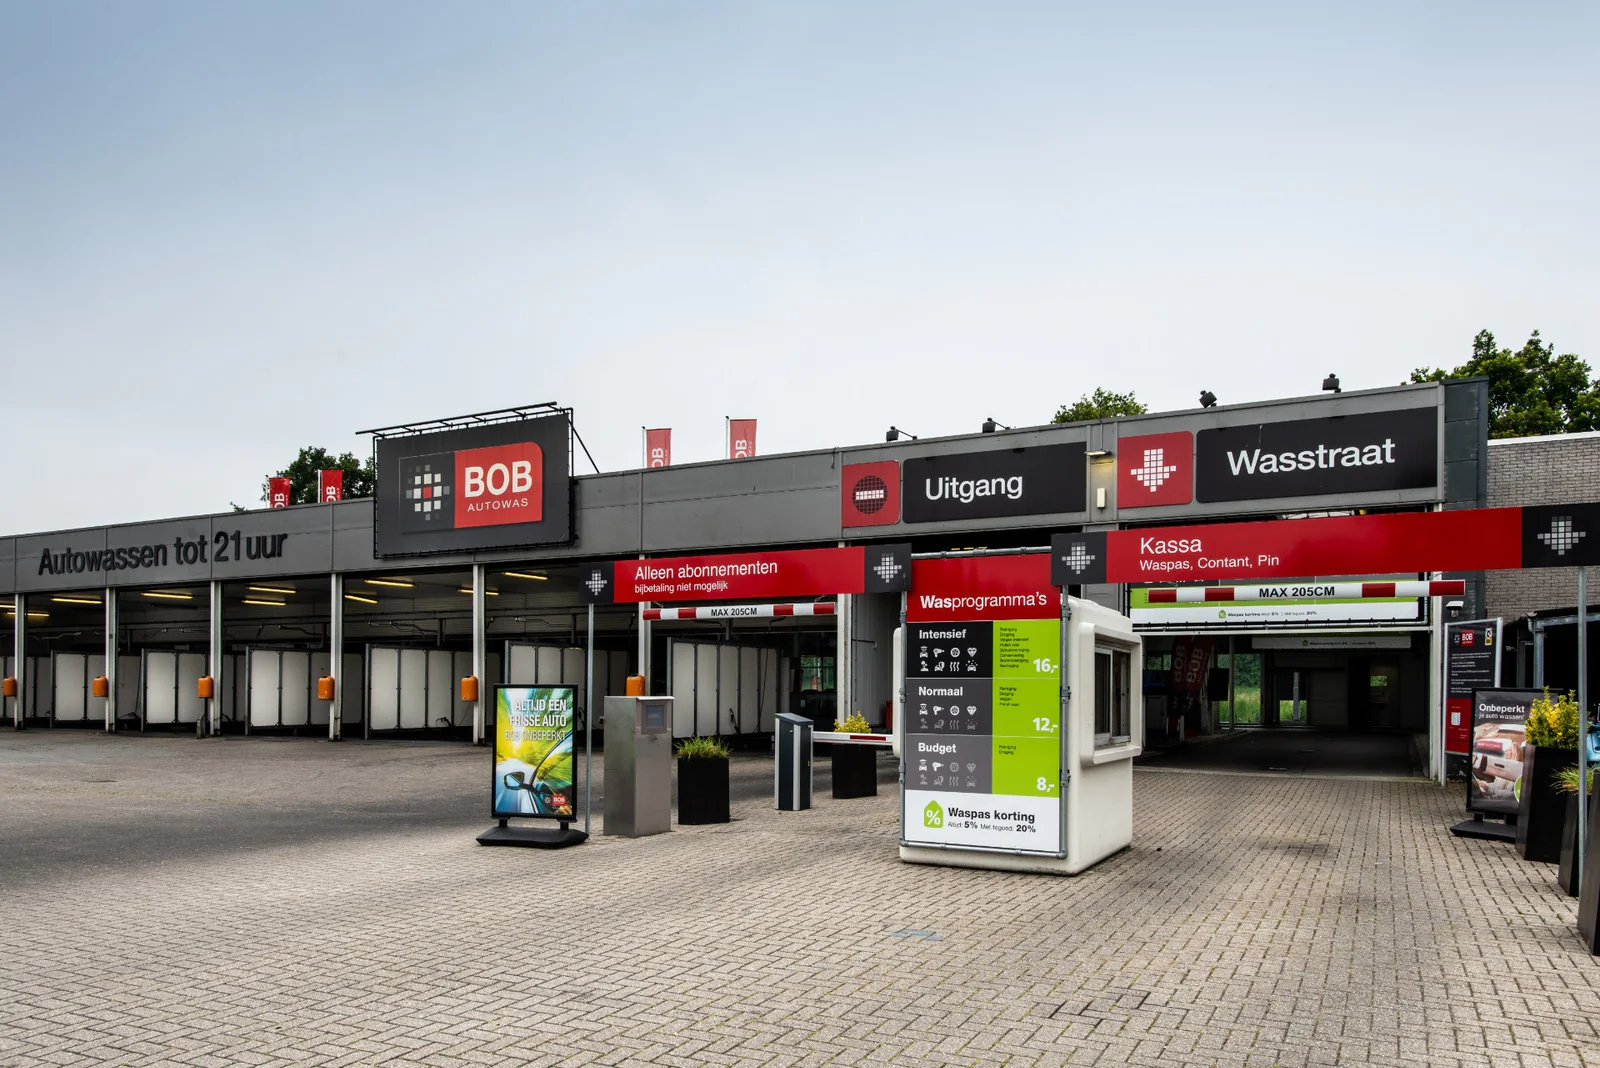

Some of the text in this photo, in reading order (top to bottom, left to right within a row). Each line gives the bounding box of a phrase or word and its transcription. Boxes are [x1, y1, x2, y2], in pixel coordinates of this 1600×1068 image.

[1226, 438, 1396, 476] Wasstraat
[464, 460, 533, 498] BOB
[925, 476, 1023, 503] Uitgang
[467, 498, 528, 512] AUTOWAS
[38, 530, 288, 576] Autowassen tot 21 uur
[1140, 537, 1202, 554] Kassa
[634, 560, 778, 580] Alleen abonnementen
[1139, 554, 1279, 572] Waspas, Contant, Pin
[634, 581, 728, 594] bijbetaling niet mogelijk
[1259, 586, 1335, 598] MAX 205CM
[920, 592, 1047, 611] Wasprogramma's
[710, 607, 757, 617] MAX 205CM
[919, 628, 967, 639] Intensief
[1033, 658, 1059, 674] 16,-
[1186, 647, 1204, 684] BOB
[918, 686, 964, 697] Normaal
[515, 699, 567, 712] ALTIJD EEN
[1478, 703, 1526, 714] Onbeperkt
[509, 714, 567, 727] FRISSE AUTO
[1032, 717, 1059, 733] 12,-
[522, 730, 566, 741] ONBEPERKT
[918, 742, 957, 754] Budget
[1036, 776, 1056, 793] 8,-
[948, 807, 1036, 824] Waspas korting
[964, 820, 979, 829] 5%
[1016, 824, 1037, 833] 20%
